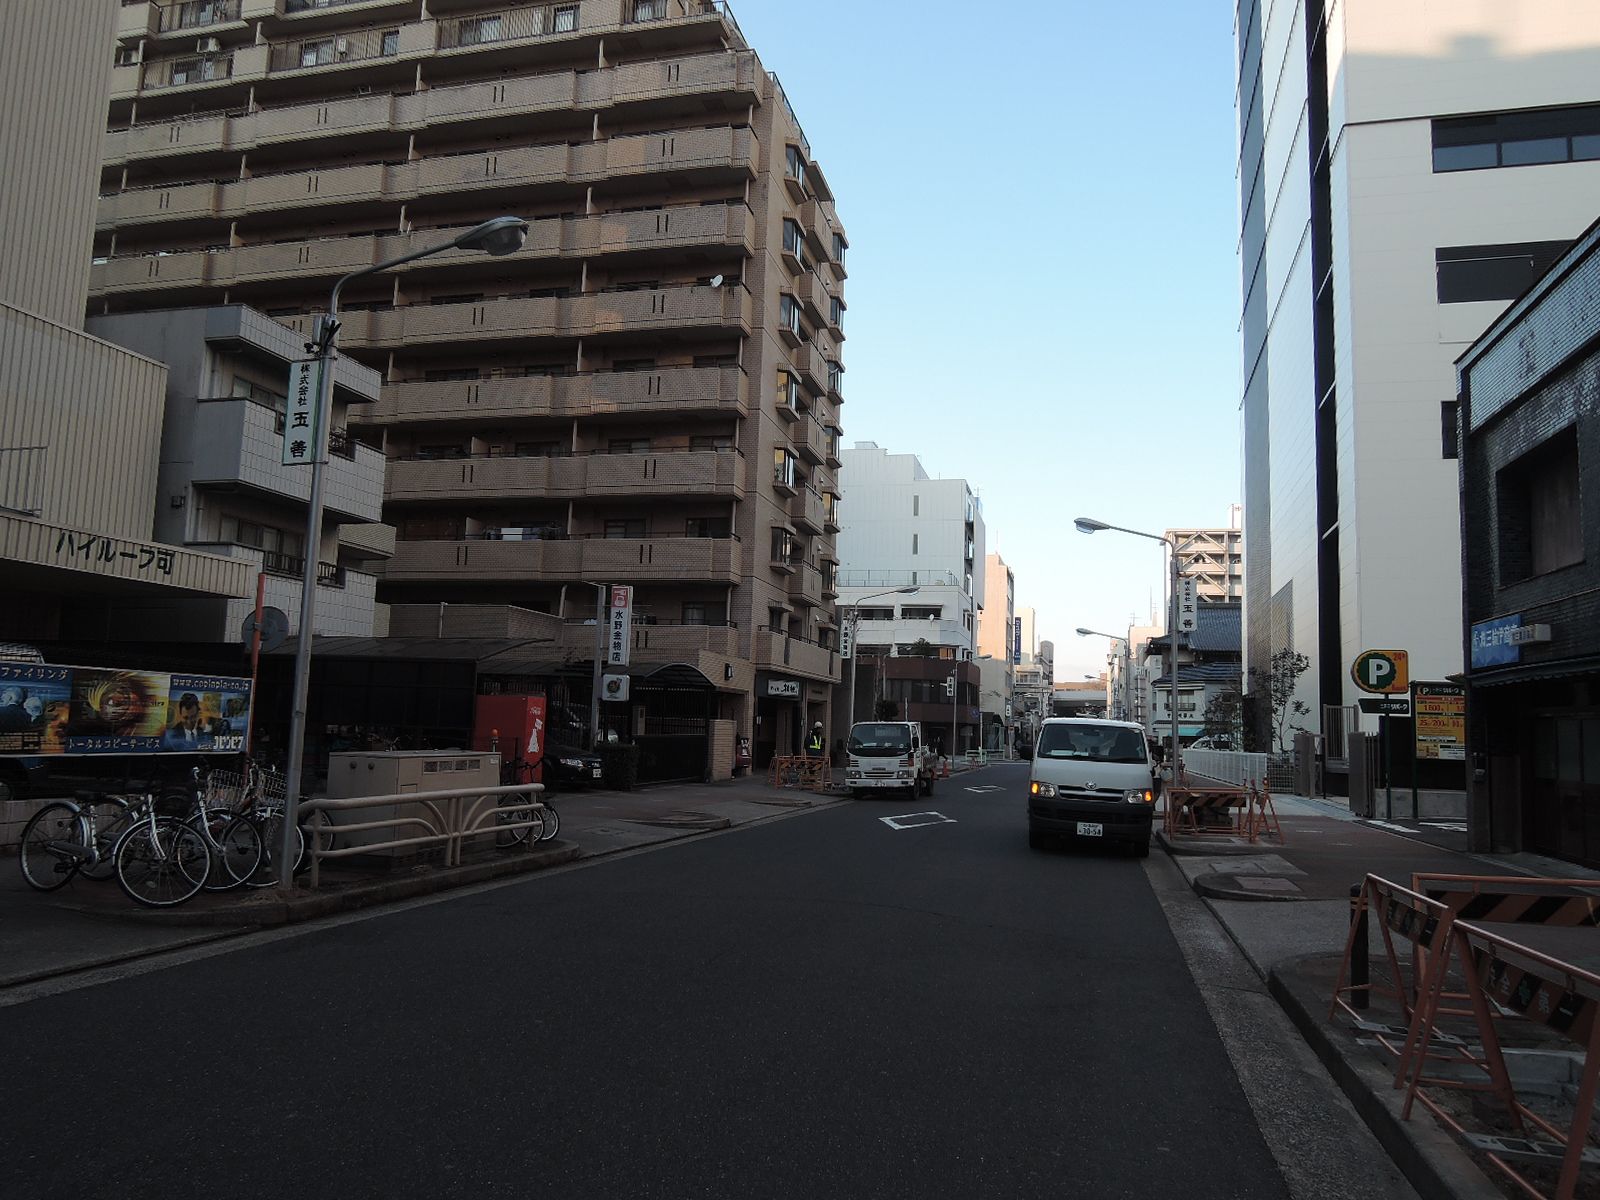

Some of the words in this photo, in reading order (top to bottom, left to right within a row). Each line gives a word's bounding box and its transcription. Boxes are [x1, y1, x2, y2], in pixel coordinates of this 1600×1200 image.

[56, 532, 175, 575] ハイルーフ可
[612, 610, 624, 662] 水野金物店
[1, 666, 69, 681] ファイリング
[1368, 658, 1391, 685] P
[69, 738, 160, 750] トータルコピーサービス
